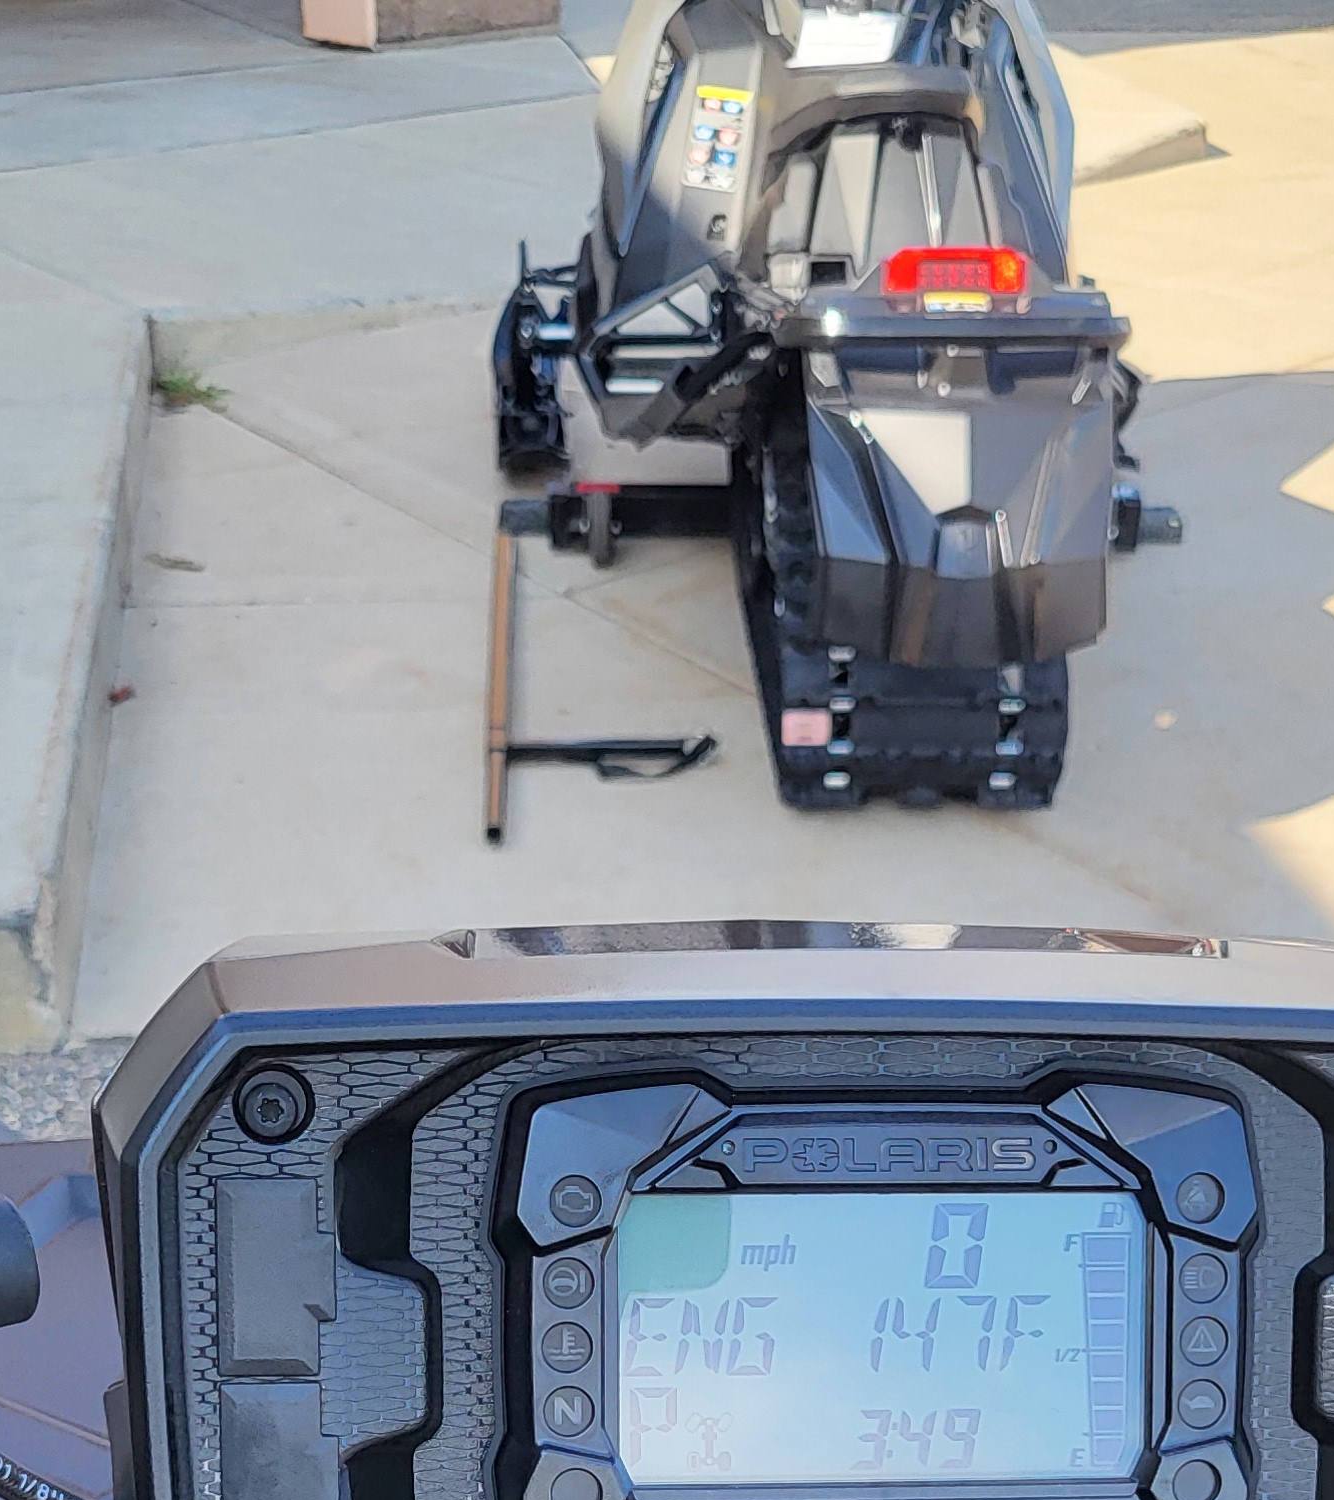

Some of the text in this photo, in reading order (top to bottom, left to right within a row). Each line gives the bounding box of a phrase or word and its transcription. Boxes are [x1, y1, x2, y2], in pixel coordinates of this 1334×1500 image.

[743, 1137, 1037, 1172] POLARIS
[740, 1203, 988, 1289] mph 0
[624, 1297, 779, 1377] ENG
[852, 1409, 982, 1470] 3:49
